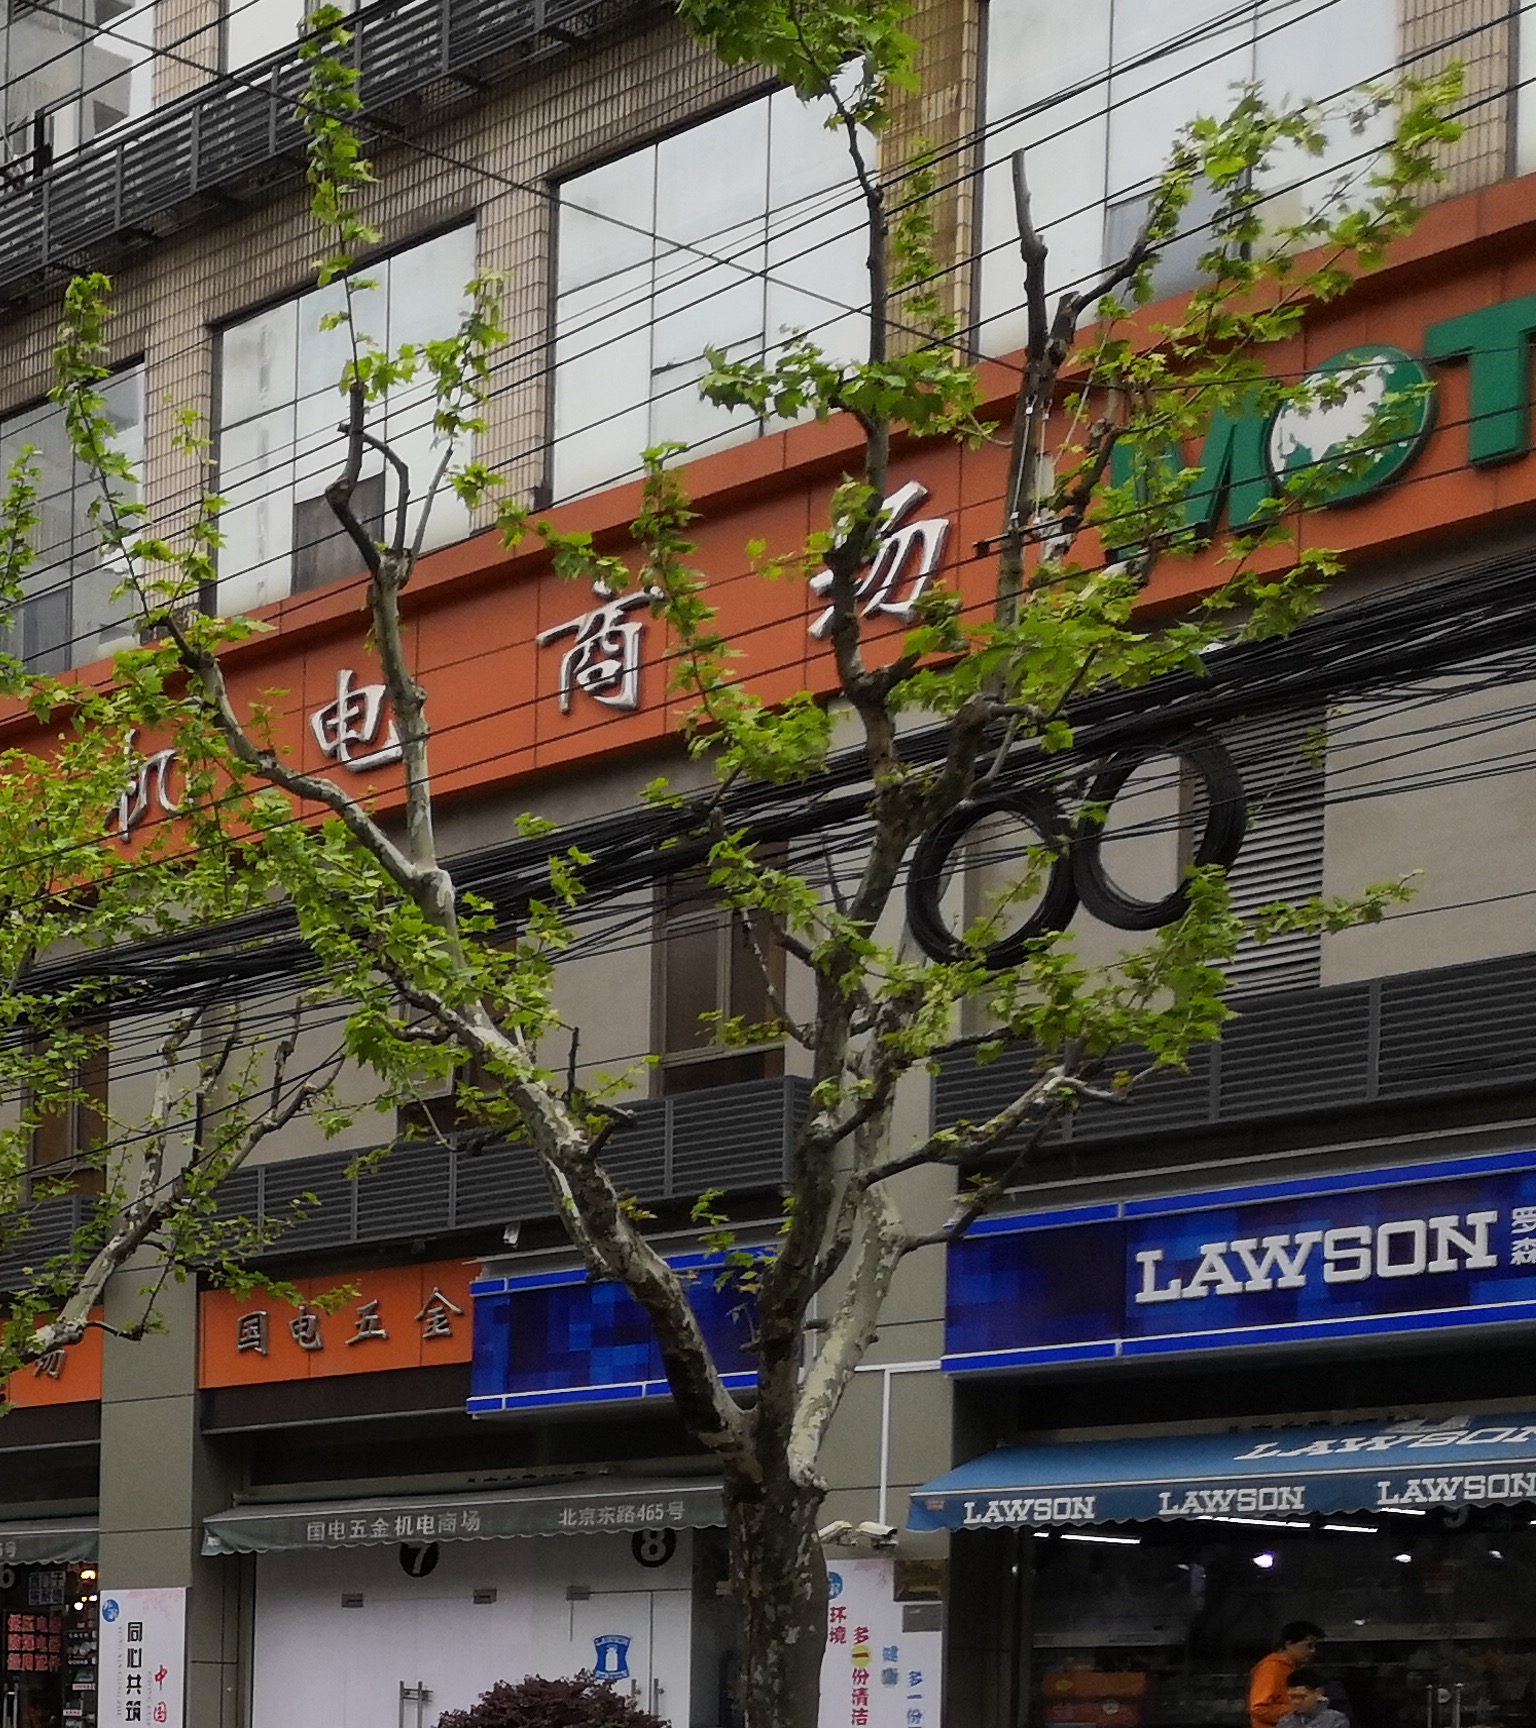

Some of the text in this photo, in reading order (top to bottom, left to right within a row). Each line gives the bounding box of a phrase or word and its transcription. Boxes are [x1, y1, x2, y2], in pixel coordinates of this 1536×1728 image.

[1134, 1209, 1498, 1304] LAWSON
[237, 1286, 464, 1356] 国电五金
[558, 1501, 686, 1527] 北京东路465号
[963, 1496, 1096, 1526] LAWSON
[1158, 1486, 1306, 1516] LAWSON
[306, 1510, 480, 1542] 国电五金机电商场
[829, 1606, 847, 1645] 环境
[126, 1621, 143, 1722] 同心共筑
[851, 1626, 870, 1727] 多一份清洁
